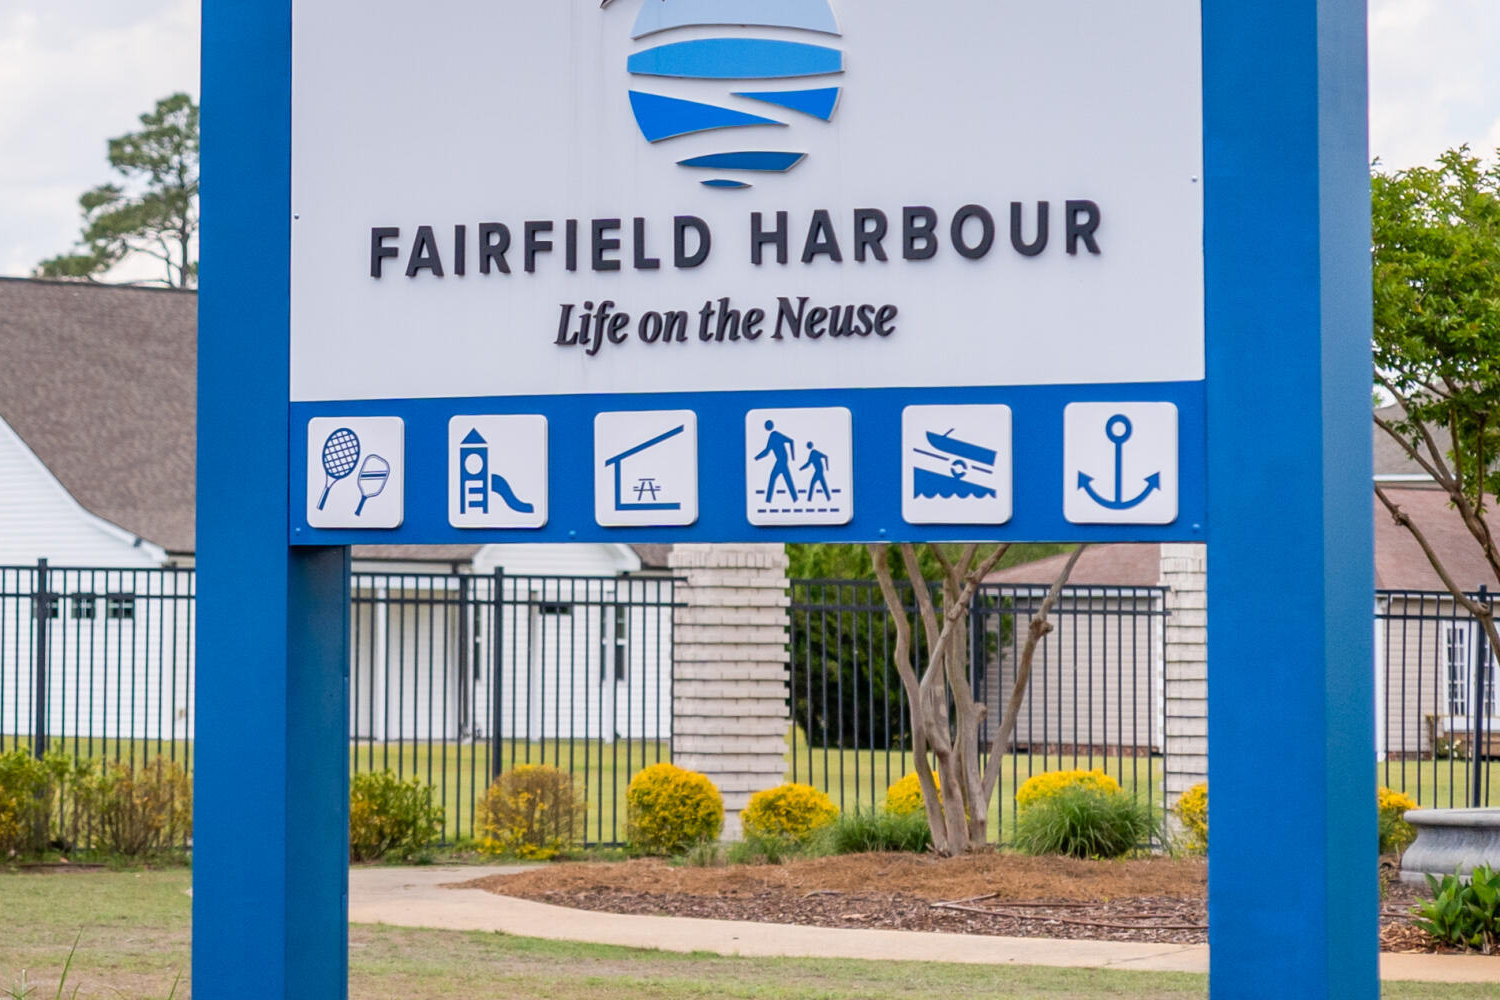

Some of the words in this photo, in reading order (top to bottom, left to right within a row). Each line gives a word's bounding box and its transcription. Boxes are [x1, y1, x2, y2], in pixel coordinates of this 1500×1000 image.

[370, 215, 712, 278] FAIRFIELD
[750, 200, 1102, 265] HARBOUR
[554, 300, 630, 356] Life
[638, 309, 688, 343] on
[698, 297, 765, 342] the
[771, 296, 898, 340] Neuse
